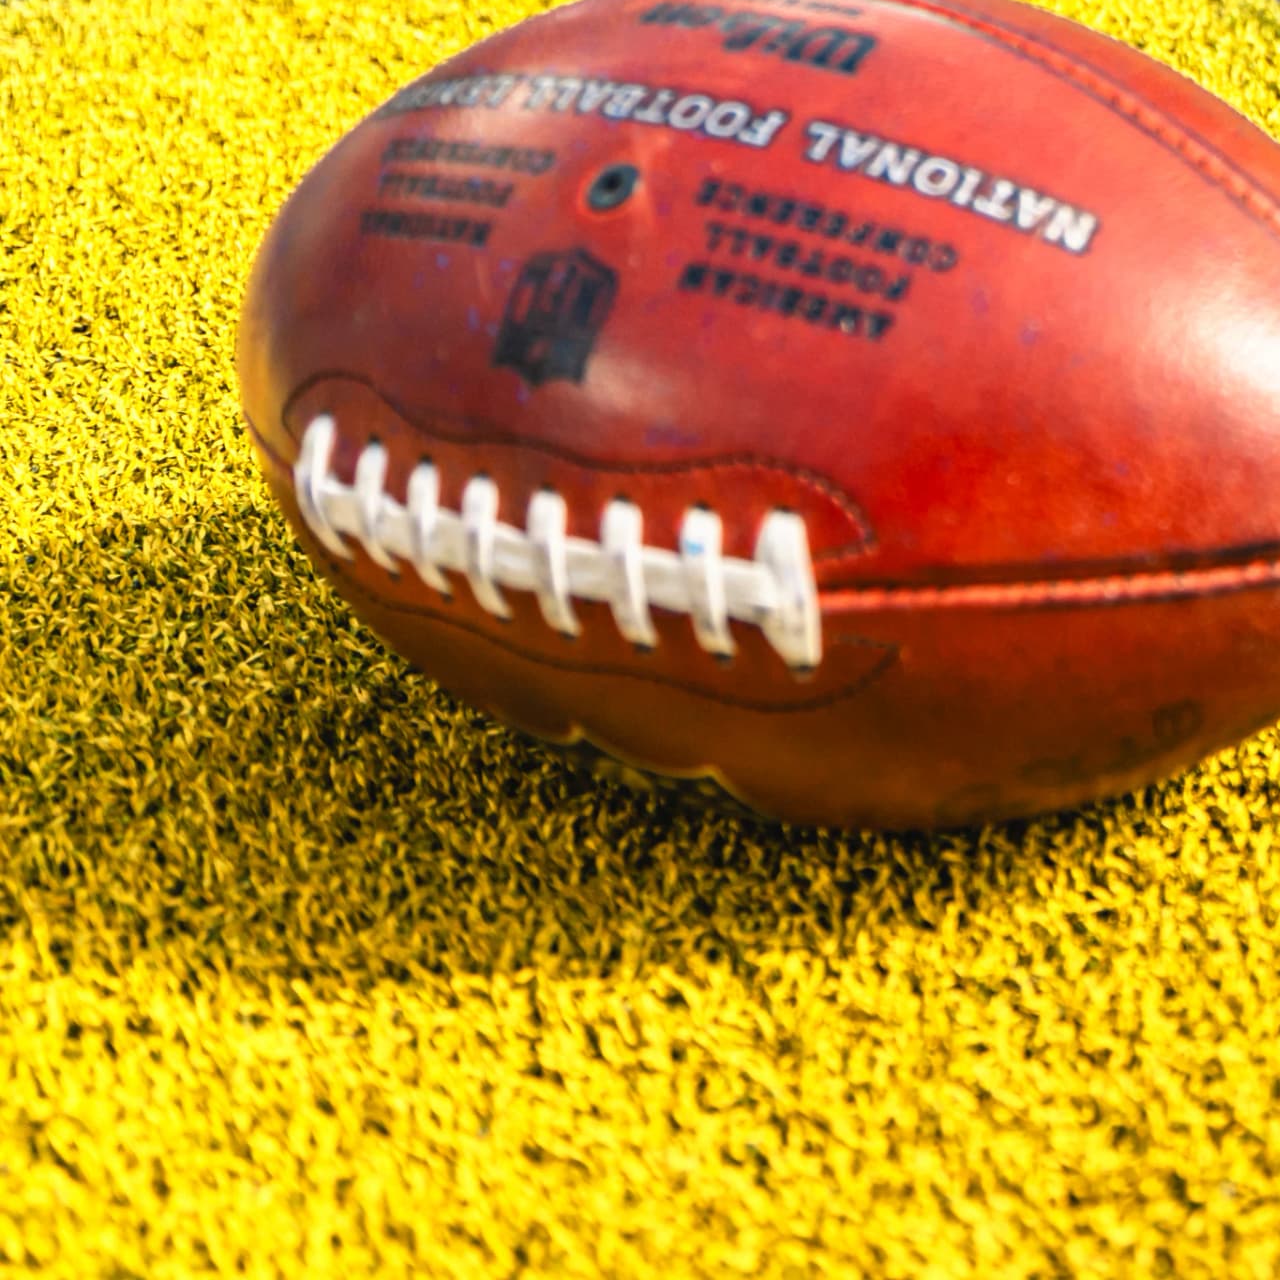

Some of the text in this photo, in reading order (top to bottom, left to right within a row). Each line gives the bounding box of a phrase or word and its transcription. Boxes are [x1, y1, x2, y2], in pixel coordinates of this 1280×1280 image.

[640, 1, 876, 77] Wilson
[523, 73, 788, 148] FOOTBALL
[696, 178, 958, 271] CONFERENCE
[804, 119, 1098, 254] NATIONAL
[705, 222, 910, 301] FOOTBALL
[677, 262, 894, 342] AMERICAN
